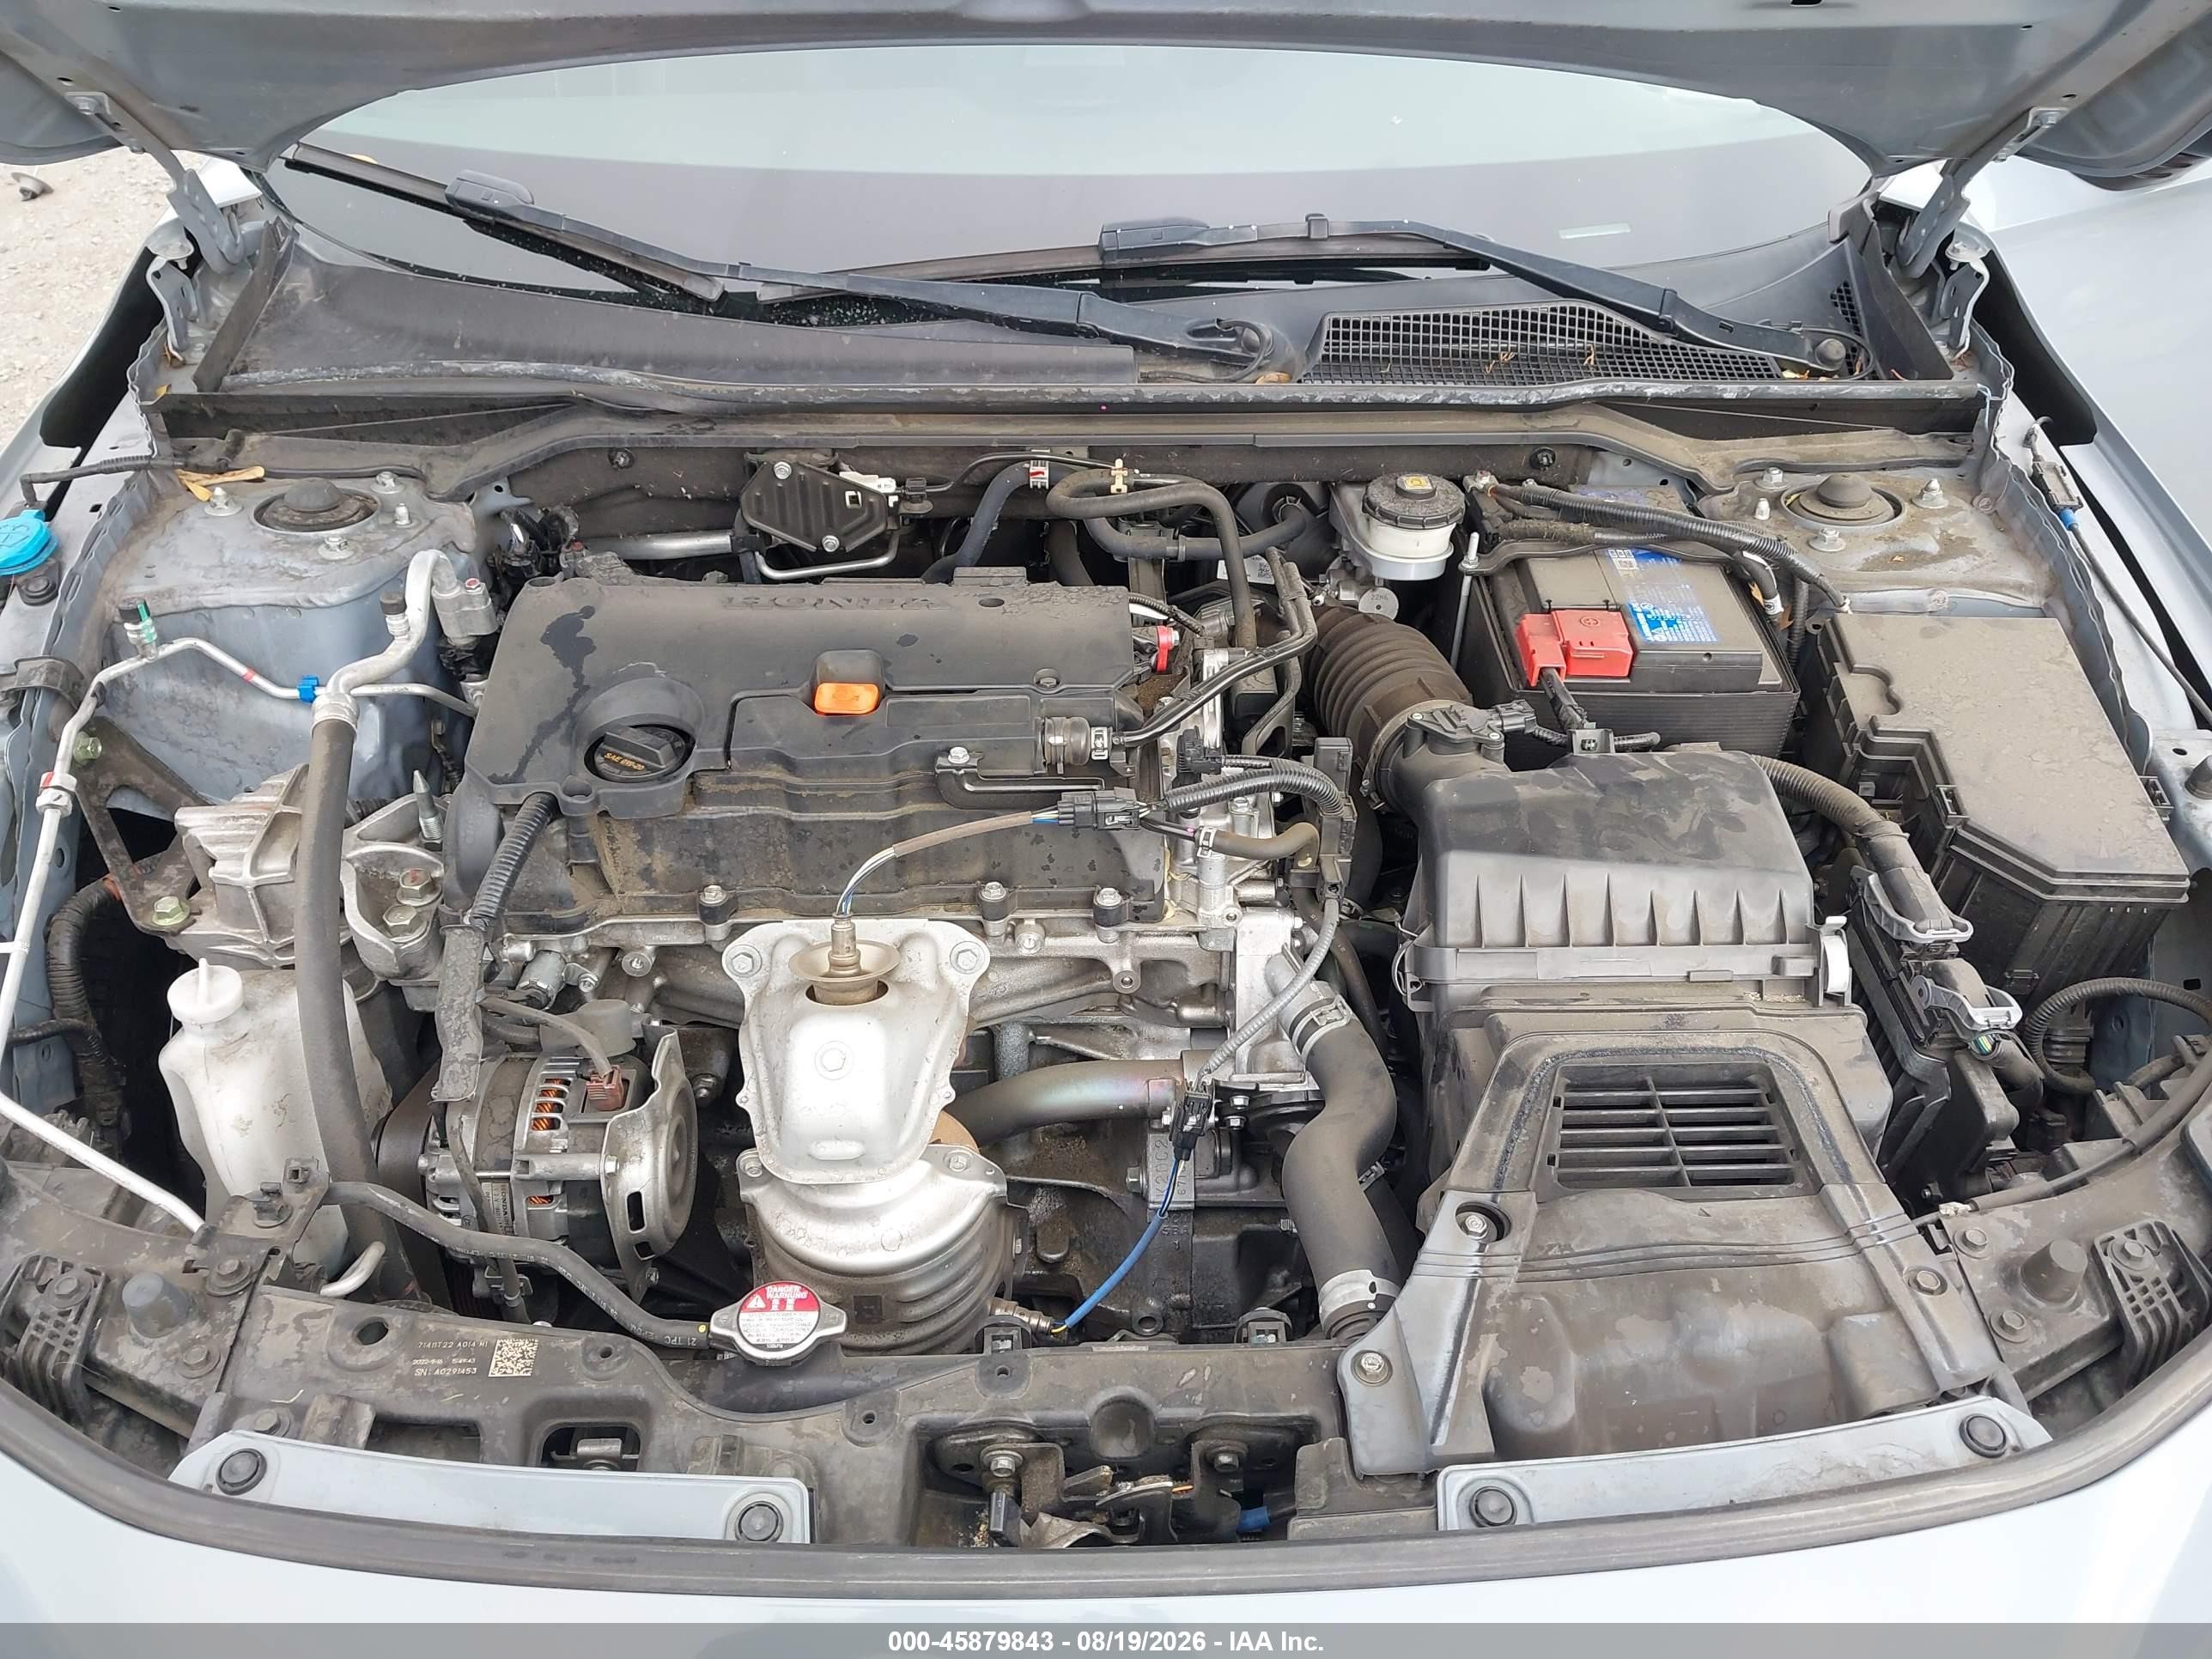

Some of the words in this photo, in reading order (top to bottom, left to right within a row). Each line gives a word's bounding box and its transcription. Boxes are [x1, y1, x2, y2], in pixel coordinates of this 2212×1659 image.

[723, 597, 951, 611] HONDA
[604, 752, 623, 763] SAE
[1154, 1139, 1170, 1198] K20C2
[457, 1340, 476, 1348] A014
[664, 1335, 682, 1346] TPC
[687, 1337, 697, 1346] 21
[434, 1367, 477, 1376] A0291453
